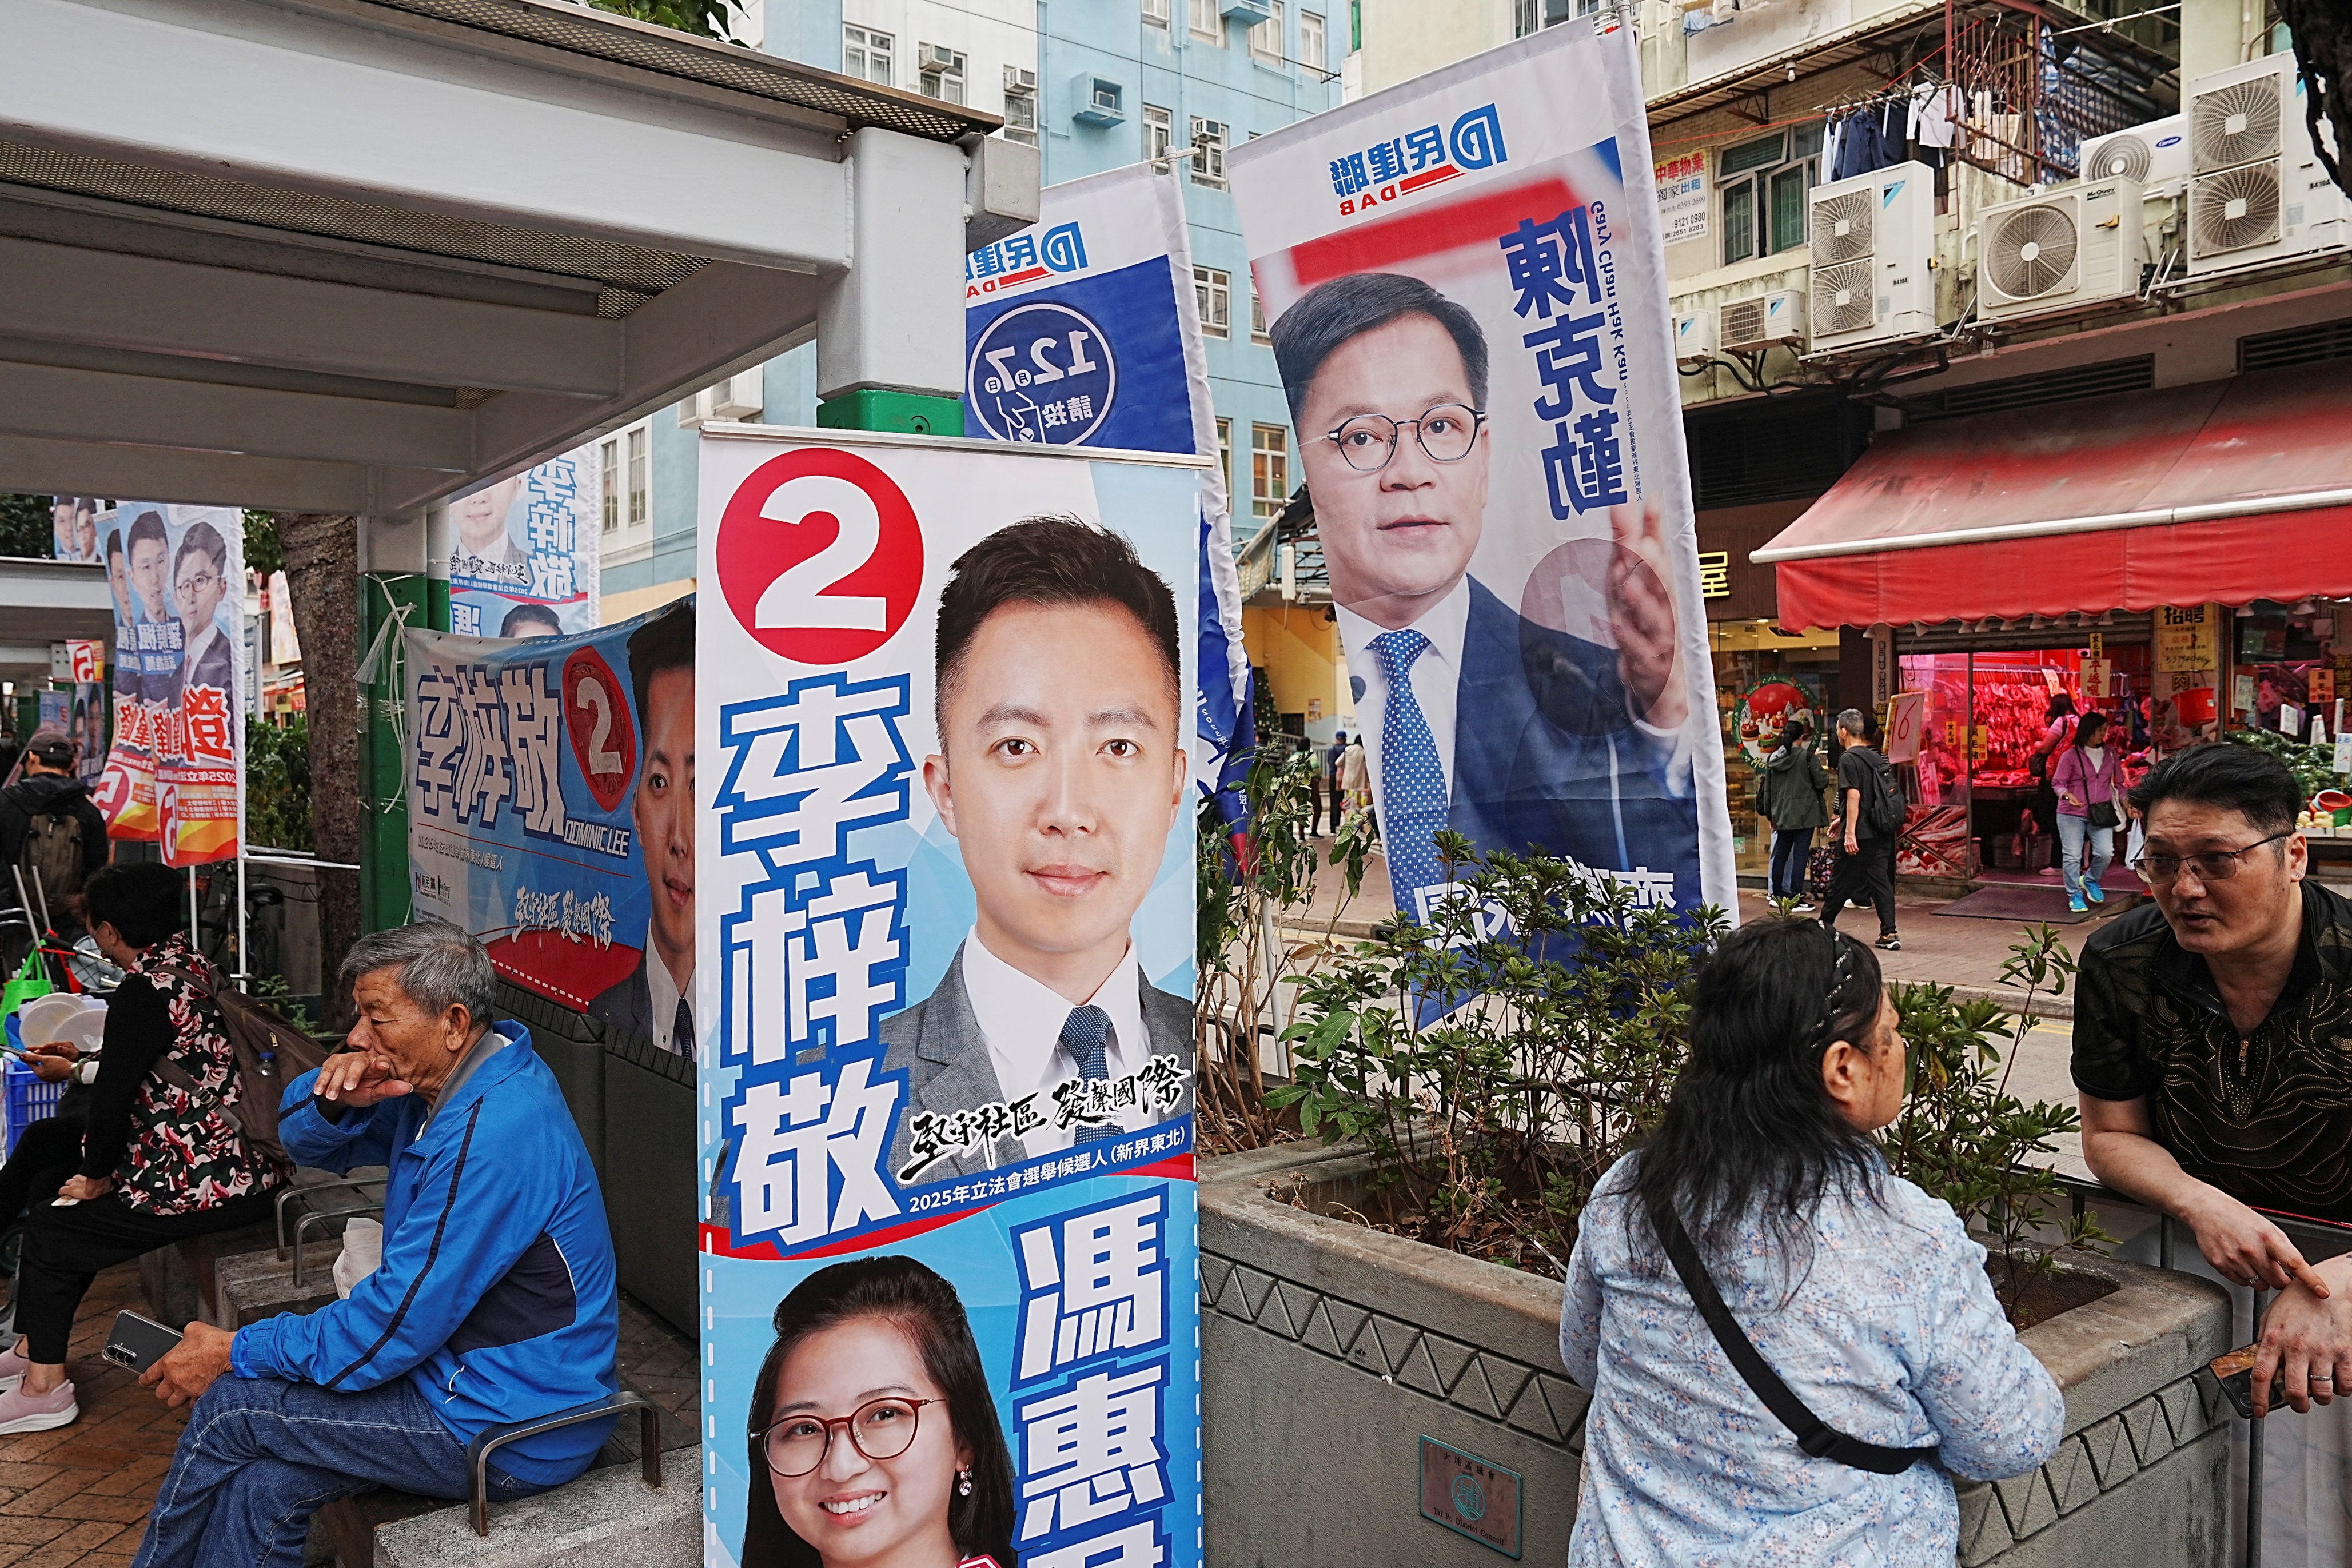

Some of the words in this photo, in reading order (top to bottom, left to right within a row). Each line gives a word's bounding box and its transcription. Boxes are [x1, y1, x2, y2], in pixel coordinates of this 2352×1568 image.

[1655, 153, 1704, 183] 中華物業
[1657, 178, 1701, 202] 獨家出租
[1677, 200, 1691, 210] 6393
[1692, 195, 1705, 206] 2699
[2087, 187, 2115, 197] McQuay
[1689, 224, 1703, 232] 8283
[1691, 212, 1705, 224] 0980
[1893, 278, 1908, 286] R410A
[755, 475, 887, 632] 2
[1698, 551, 1730, 598] 屋
[2172, 673, 2189, 691] 肉
[576, 677, 623, 775] 2
[1891, 700, 1918, 750] 16
[416, 664, 566, 837] 李梓敬
[564, 820, 608, 853] DOMINIC
[607, 829, 630, 857] LEE
[511, 885, 561, 952] 堅守社區
[559, 889, 616, 952] 發聲國際
[719, 675, 911, 1253] 李梓敬
[900, 1091, 1047, 1181] 堅守社區
[1045, 1056, 1190, 1125] 發聲國際
[908, 1125, 1186, 1215] 2025年立法會選舉候選人（新界東北）
[1016, 1192, 1166, 1568] 馮惠
[1443, 1452, 1496, 1481] 大埔區議會
[1433, 1507, 1443, 1518] Tai
[1445, 1513, 1453, 1522] Po
[1455, 1518, 1478, 1534] District
[1480, 1529, 1505, 1546] Council
